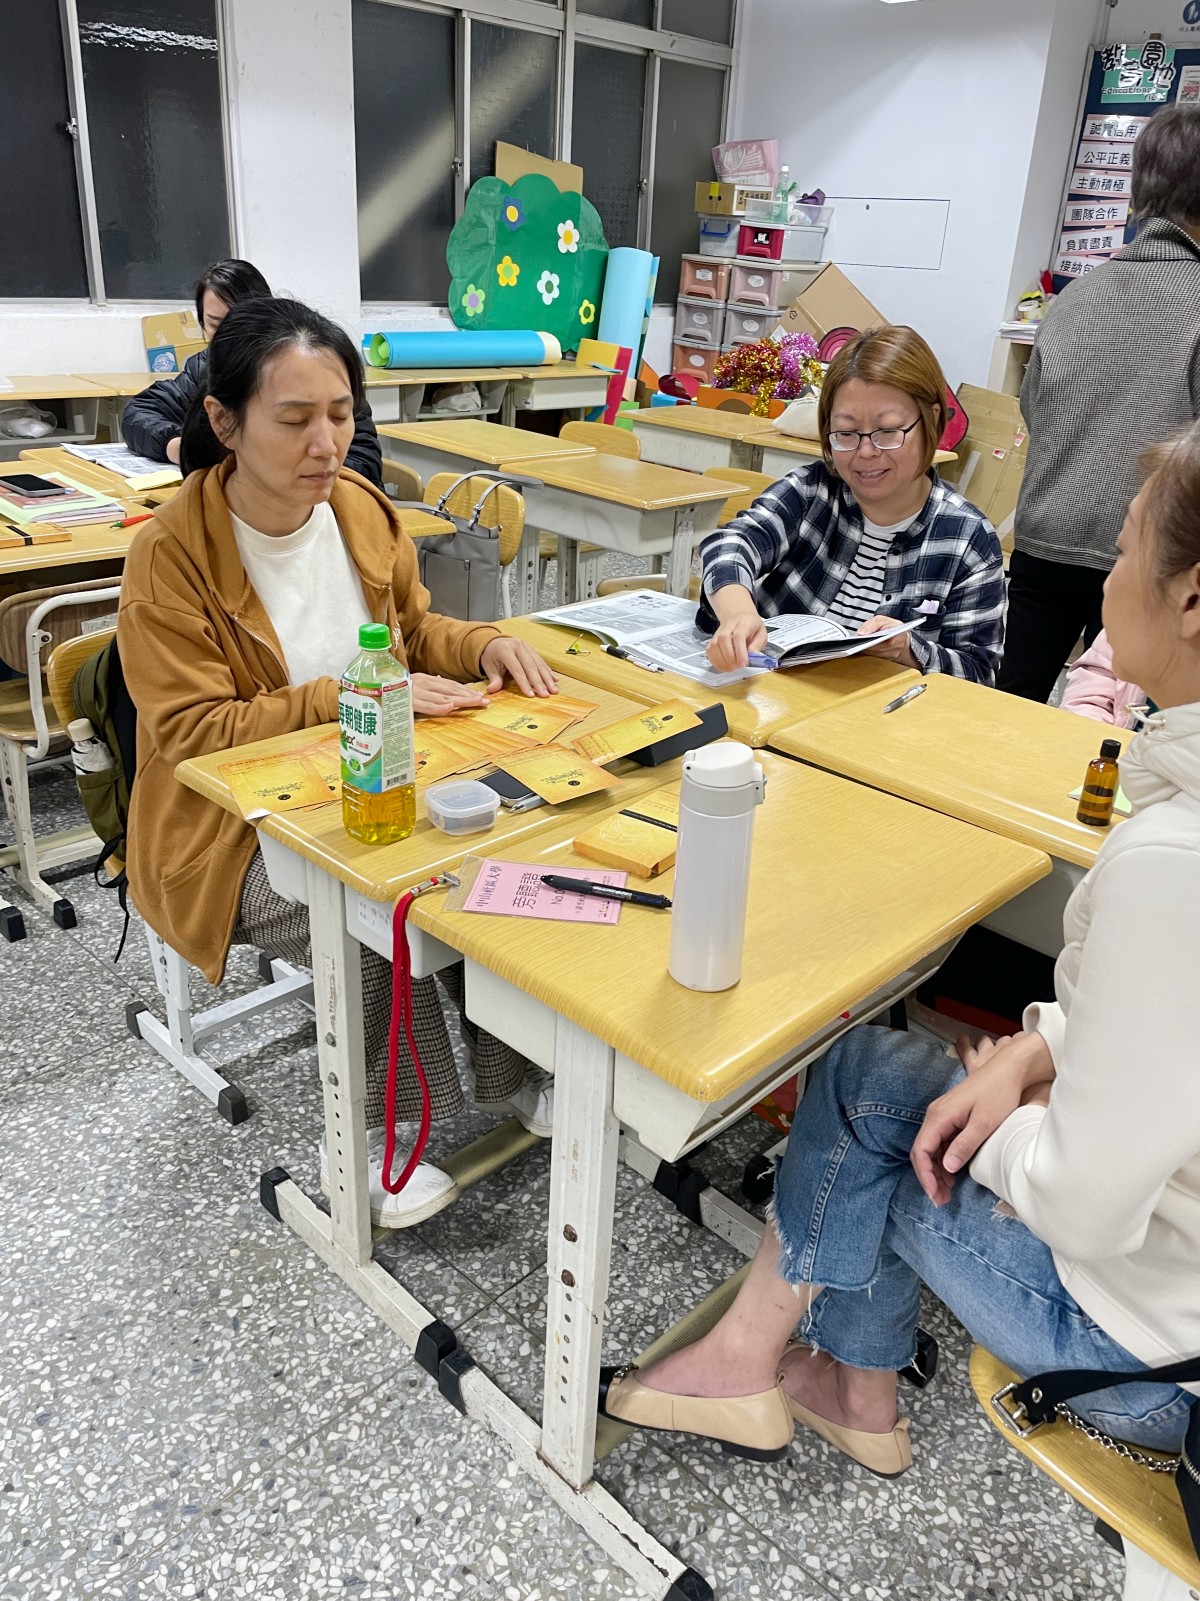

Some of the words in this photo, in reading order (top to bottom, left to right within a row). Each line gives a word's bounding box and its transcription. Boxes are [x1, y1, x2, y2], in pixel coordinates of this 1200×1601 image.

[1089, 123, 1138, 138] 誠實信用
[1084, 151, 1131, 166] 公平正義
[1076, 177, 1124, 192] 主動積極
[1071, 208, 1118, 221] 團隊合作
[1066, 235, 1113, 251] 負責盡責
[475, 865, 502, 907] 中山社區大學
[512, 872, 543, 910] 旁聽證
